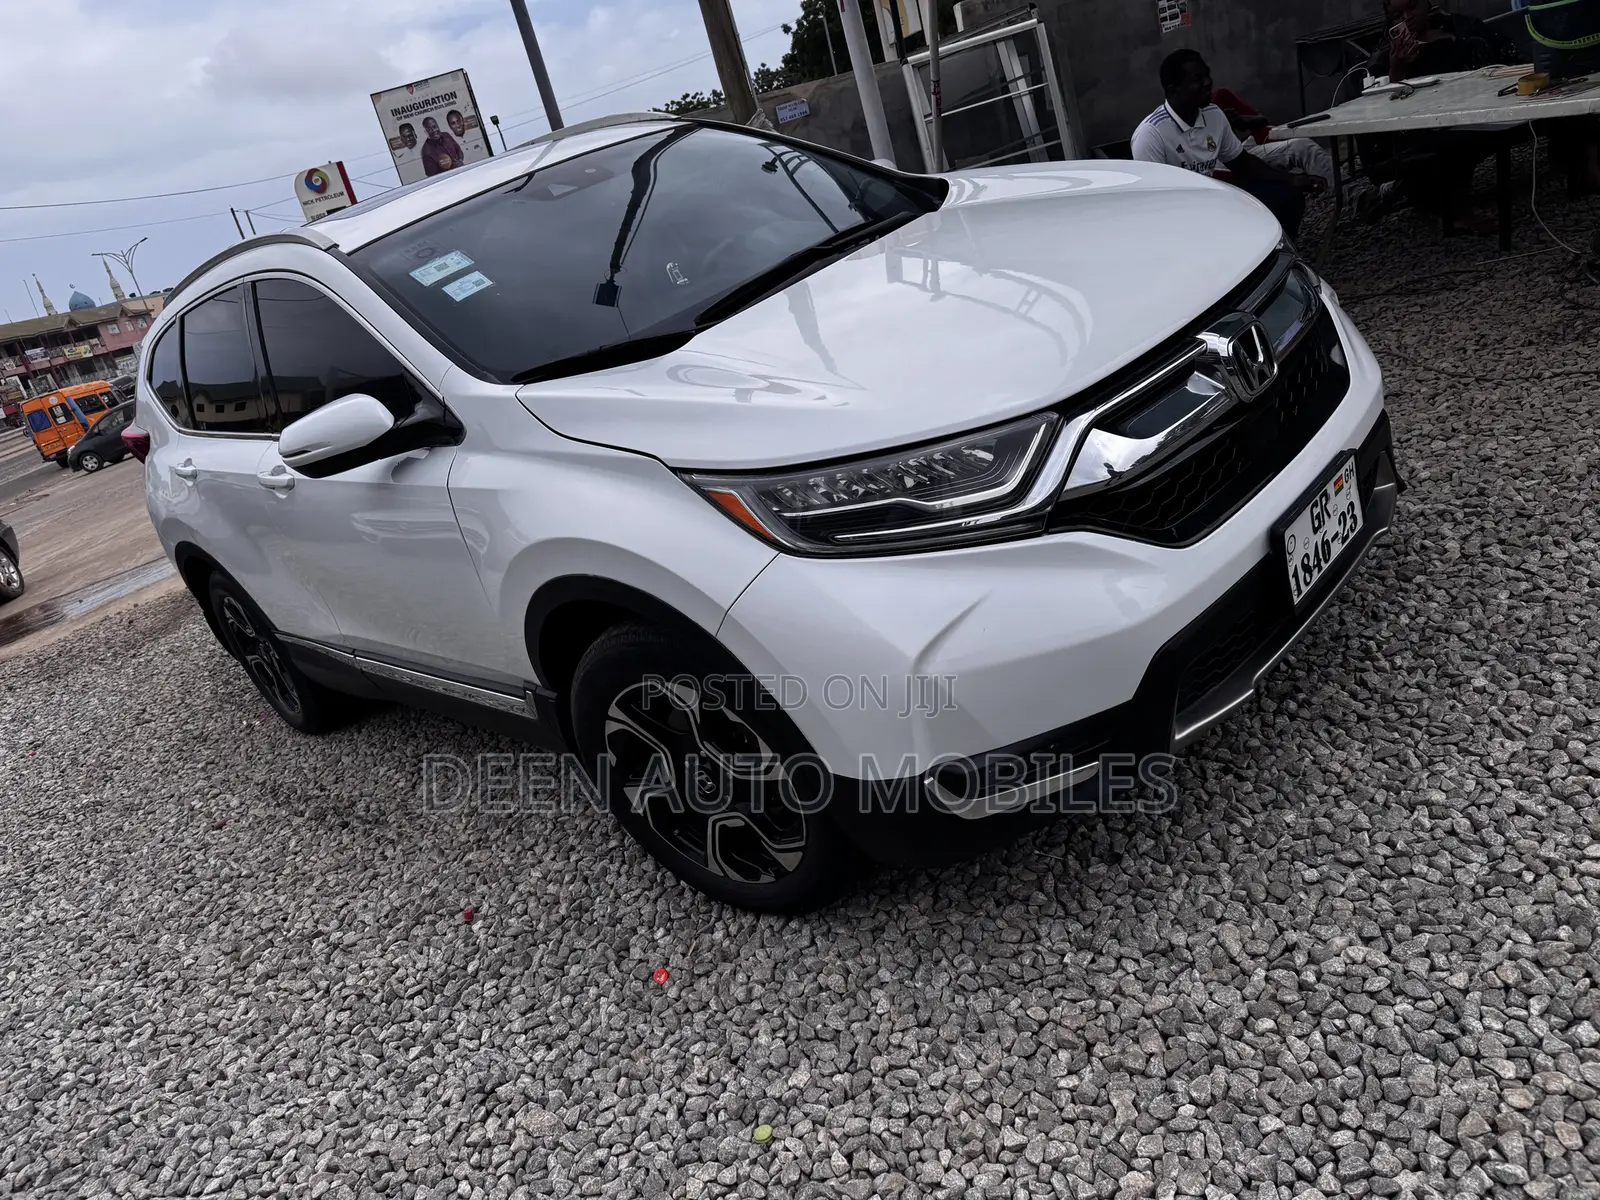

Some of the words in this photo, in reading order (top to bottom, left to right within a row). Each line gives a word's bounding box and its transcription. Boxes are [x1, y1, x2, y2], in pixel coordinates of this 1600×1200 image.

[390, 90, 458, 117] INAUGURATION
[403, 112, 415, 120] NEW
[414, 107, 435, 116] CHURCH
[315, 191, 345, 203] PETROLEUM
[1343, 461, 1355, 484] GH
[1310, 488, 1332, 535] GR
[1291, 500, 1358, 599] 1846-23
